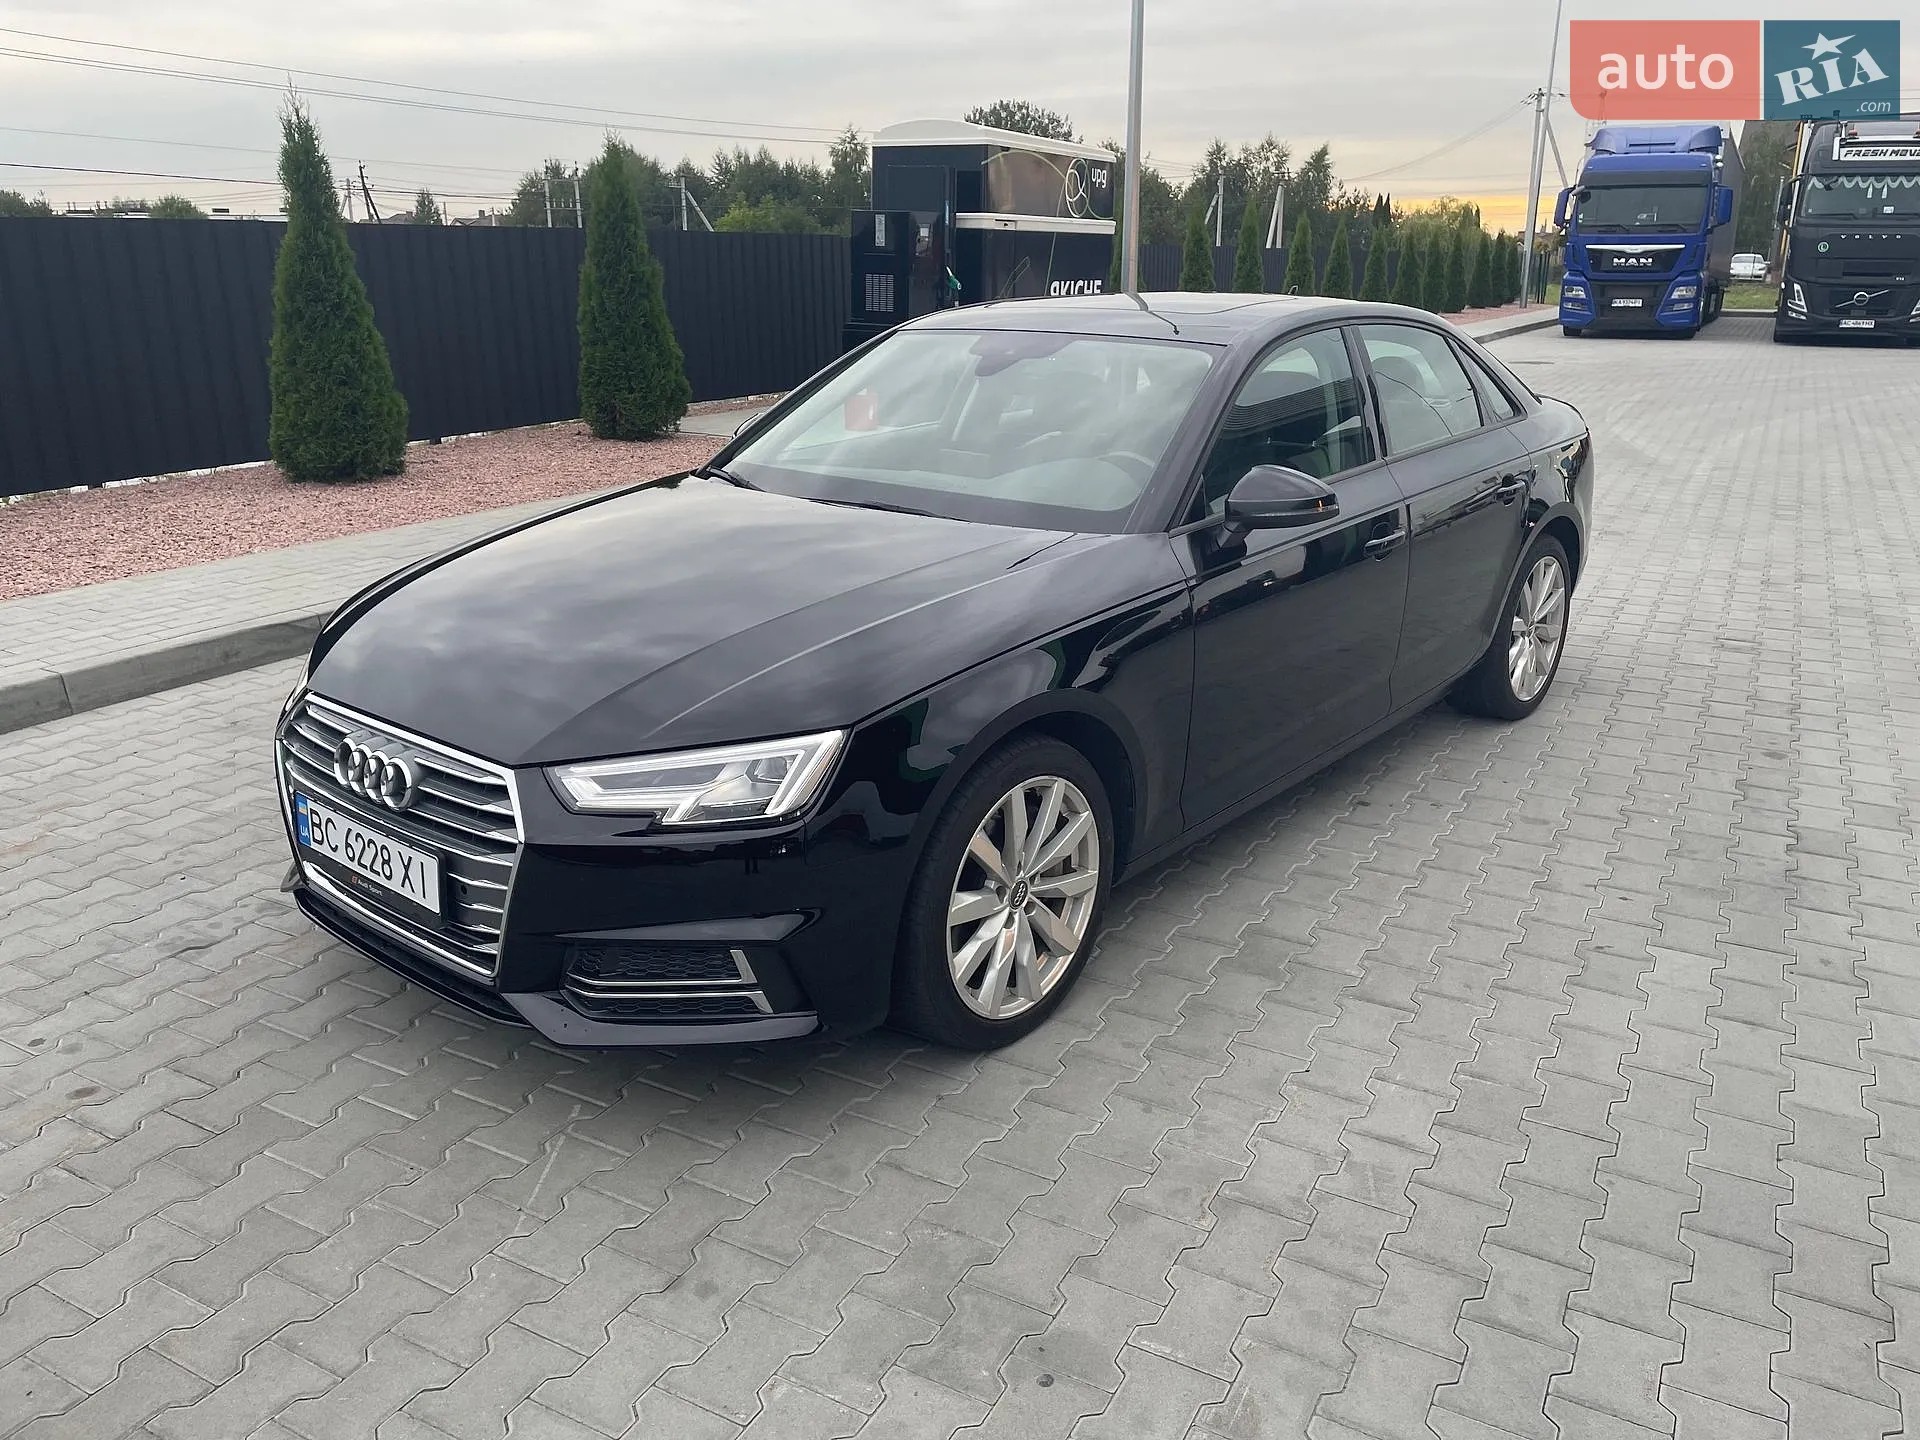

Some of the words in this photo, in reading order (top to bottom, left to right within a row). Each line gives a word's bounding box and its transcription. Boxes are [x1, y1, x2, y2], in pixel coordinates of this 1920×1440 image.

[1844, 149, 1889, 157] FRESH
[1091, 167, 1107, 189] upg
[1613, 257, 1653, 266] MAN
[300, 825, 309, 838] UA
[309, 807, 339, 853] BC
[344, 827, 393, 881] 6228
[397, 850, 426, 899] XI
